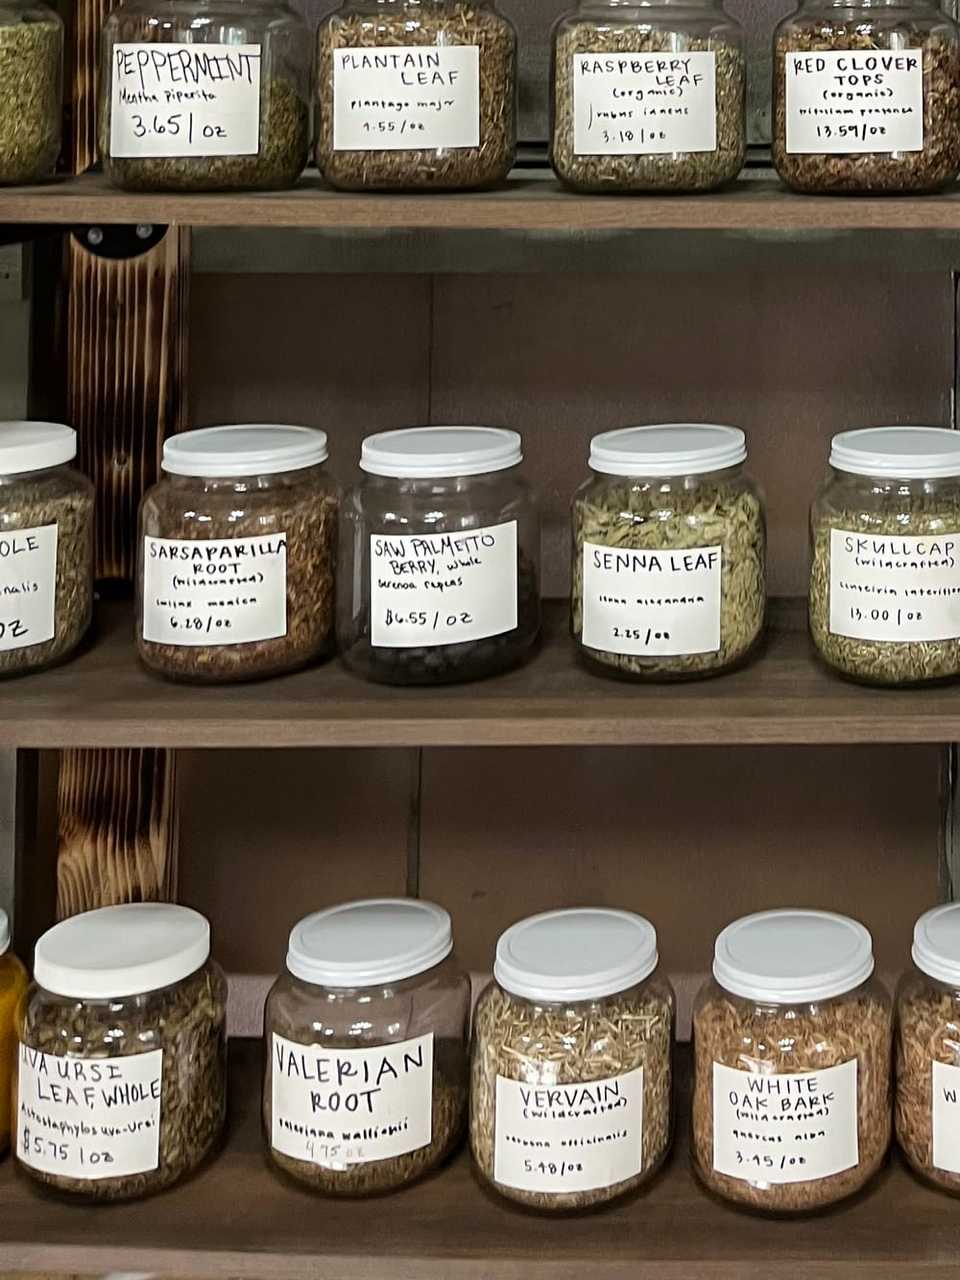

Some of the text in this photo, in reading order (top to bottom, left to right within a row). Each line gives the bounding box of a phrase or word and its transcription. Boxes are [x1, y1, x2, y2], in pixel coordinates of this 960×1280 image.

[115, 49, 260, 89] PEPPERMINT
[341, 51, 440, 71] PLANTAIN
[580, 57, 692, 76] RASPBERRY
[793, 55, 919, 77] RED CLOVER
[400, 70, 459, 86] LEAF
[655, 73, 704, 86] LEAF
[832, 72, 885, 87] TOPS
[149, 539, 287, 560] SARSAPARILLA
[374, 533, 496, 559] SAW PALMETTO
[844, 536, 955, 557] SKULLCAP
[192, 562, 242, 576] ROOT
[593, 549, 719, 574] SENNA LEAF
[56, 1060, 123, 1083] URSI
[275, 1041, 424, 1087] VALERIAN
[100, 1078, 160, 1108] WHOLE
[519, 1081, 620, 1109] VERVAIN
[746, 1076, 819, 1096] WHITE
[309, 1087, 382, 1114] ROOT
[728, 1090, 769, 1112] OAK
[780, 1090, 835, 1113] BARK
